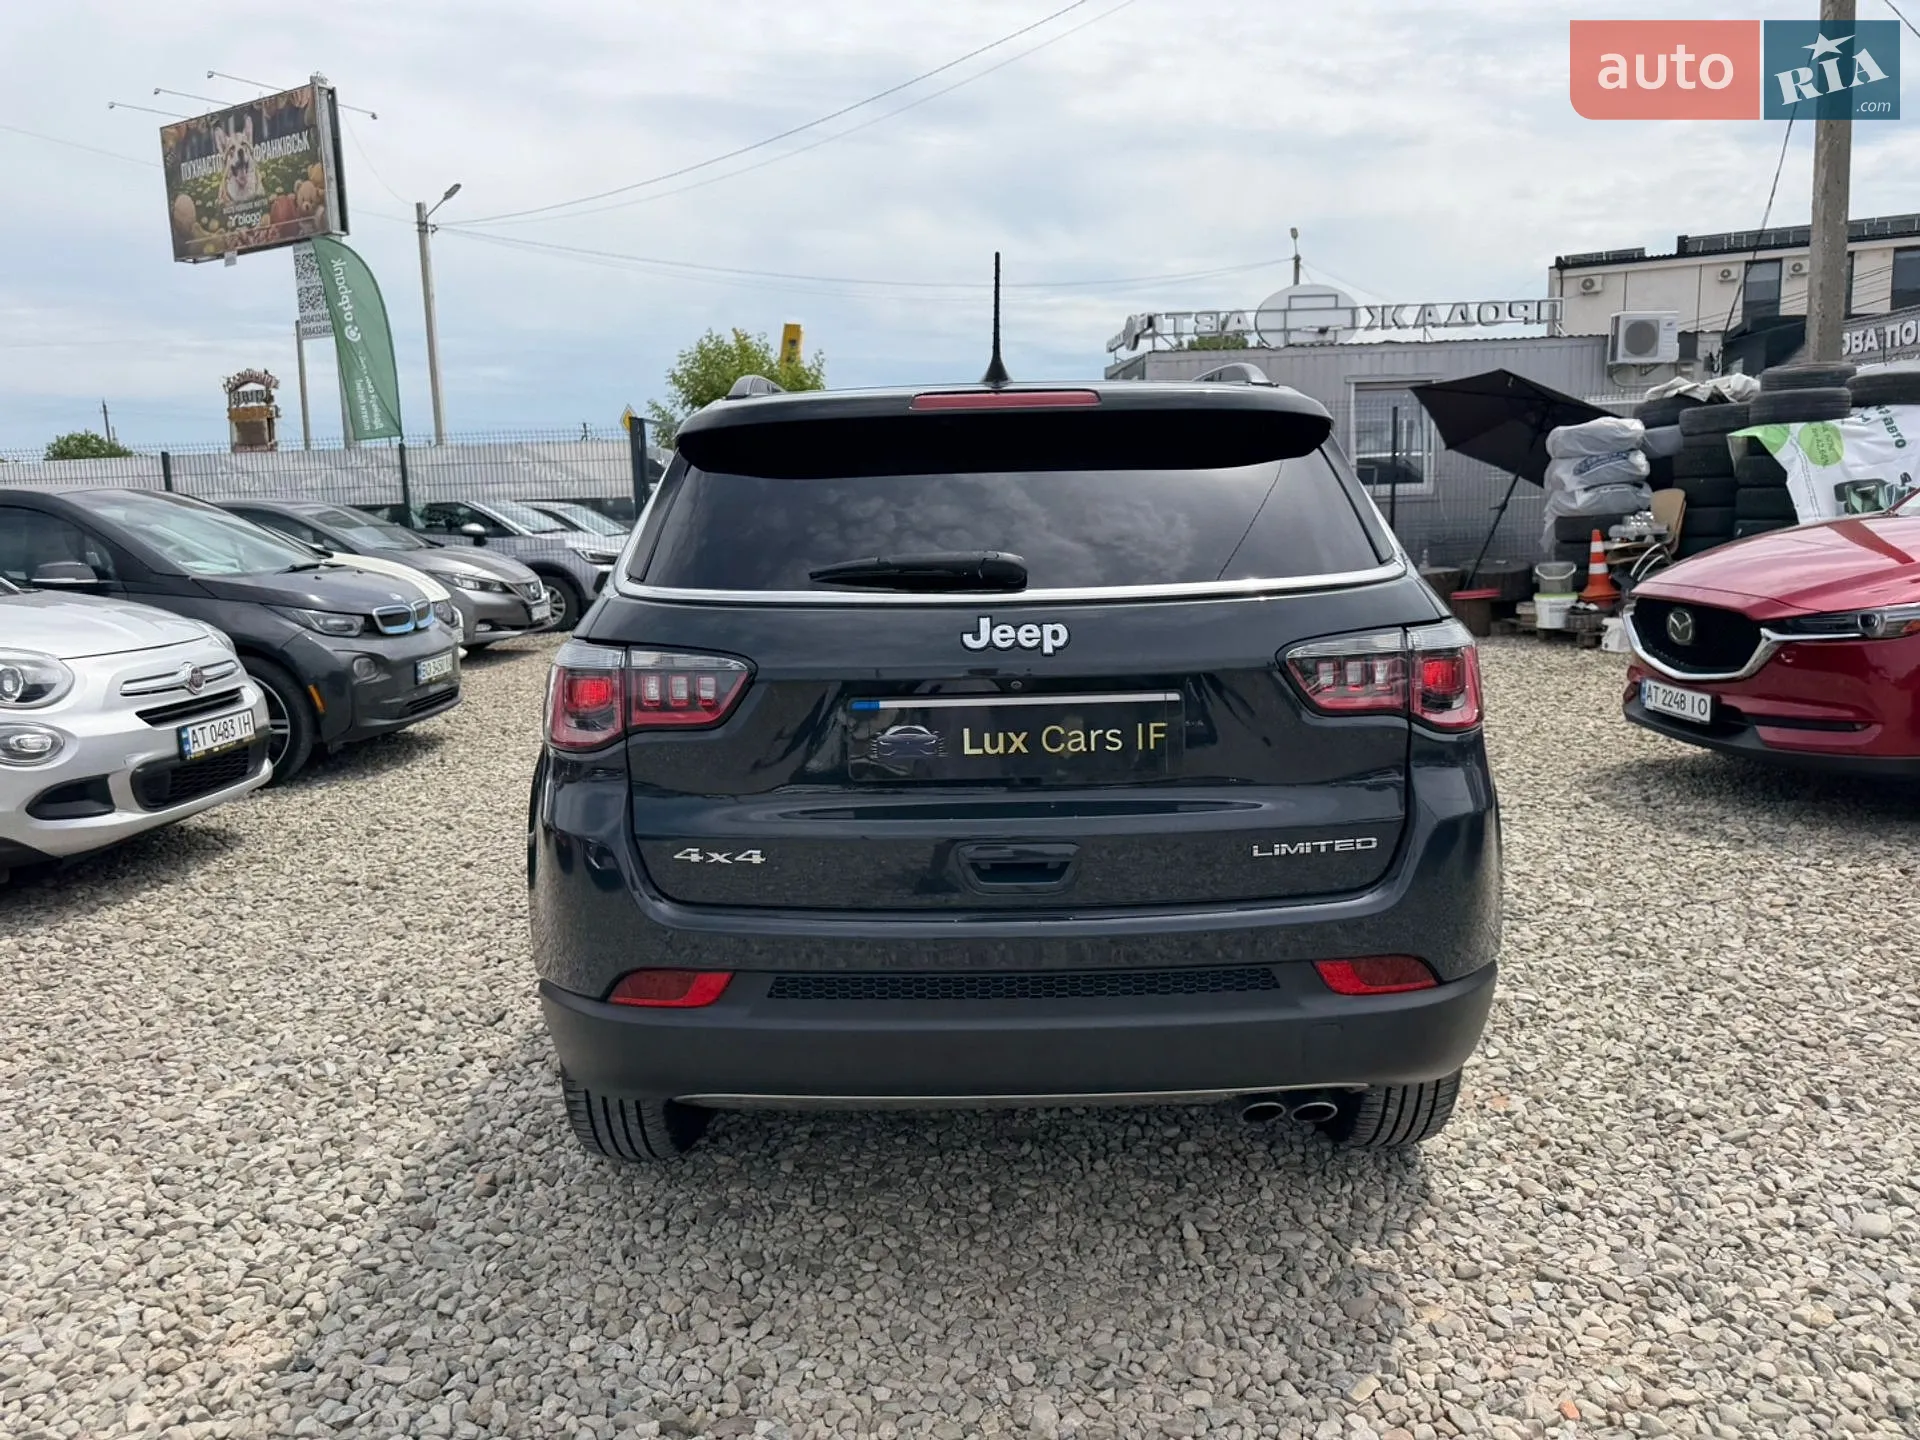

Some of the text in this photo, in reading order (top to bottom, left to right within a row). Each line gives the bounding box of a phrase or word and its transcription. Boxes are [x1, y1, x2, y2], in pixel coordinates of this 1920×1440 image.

[961, 616, 1070, 655] Jeep
[1661, 688, 1687, 711] 2248
[191, 726, 207, 750] AT
[209, 718, 236, 743] 0483
[962, 722, 1169, 756] Lux Cars IF
[673, 847, 766, 864] 4x4
[1252, 837, 1378, 857] LIMITED
